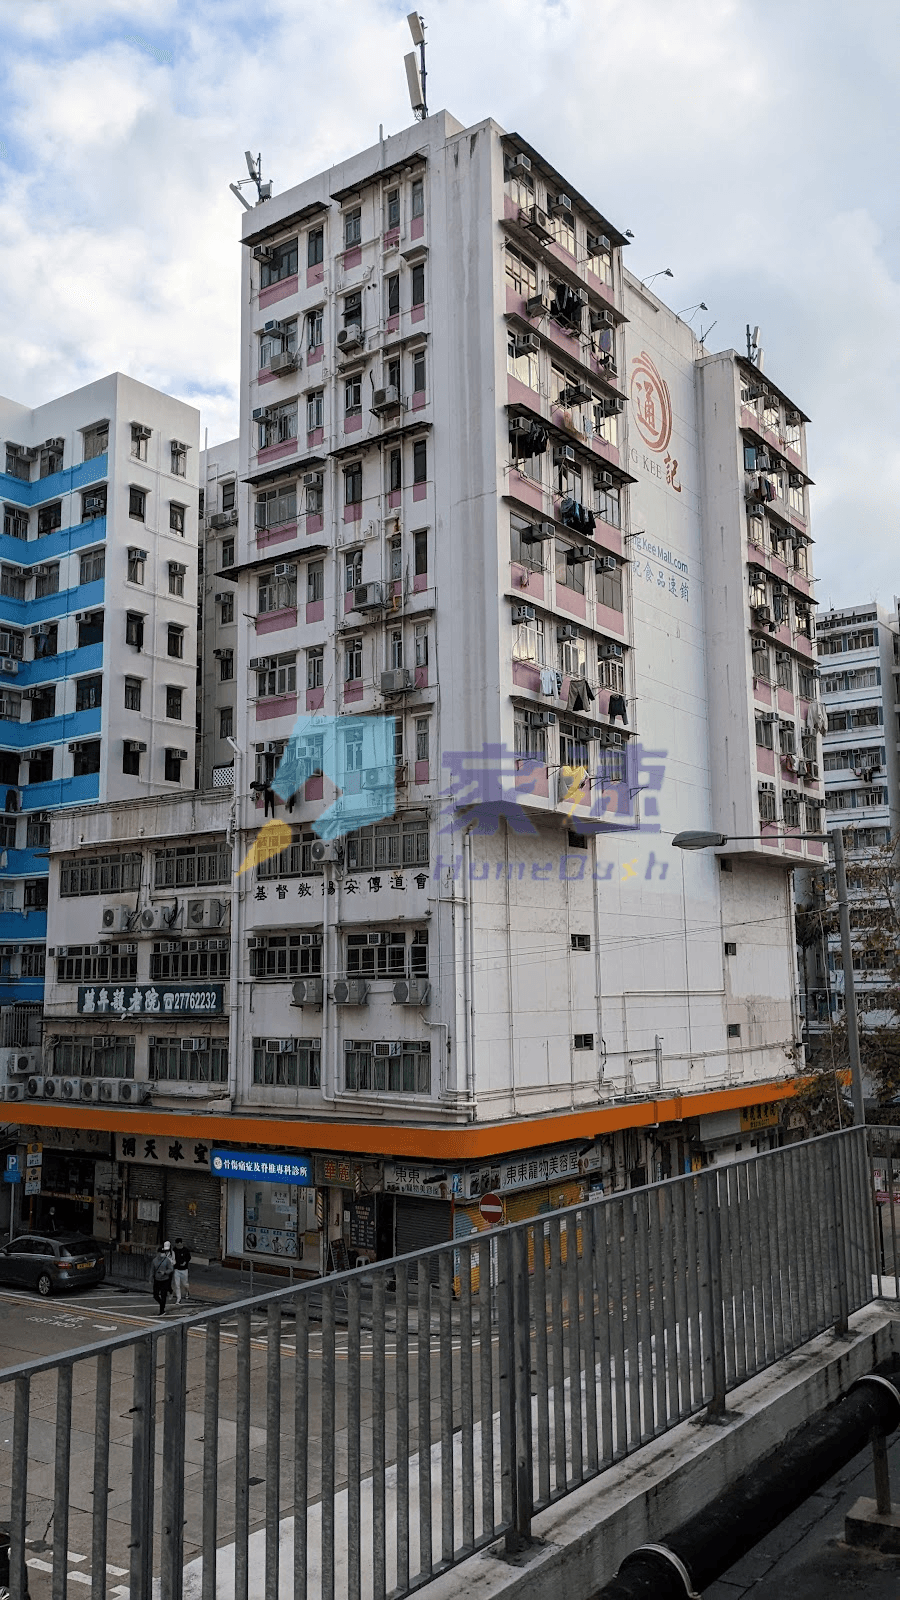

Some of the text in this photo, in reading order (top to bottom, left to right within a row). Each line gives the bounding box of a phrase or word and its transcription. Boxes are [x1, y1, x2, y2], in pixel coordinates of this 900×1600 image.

[636, 380, 659, 436] 通
[643, 455, 662, 480] KEE
[663, 451, 682, 493] 記
[174, 991, 217, 1010] 27762232
[9, 1156, 17, 1169] P
[324, 1159, 363, 1183] 華麗
[506, 1151, 578, 1185] 東東寵物美容屋
